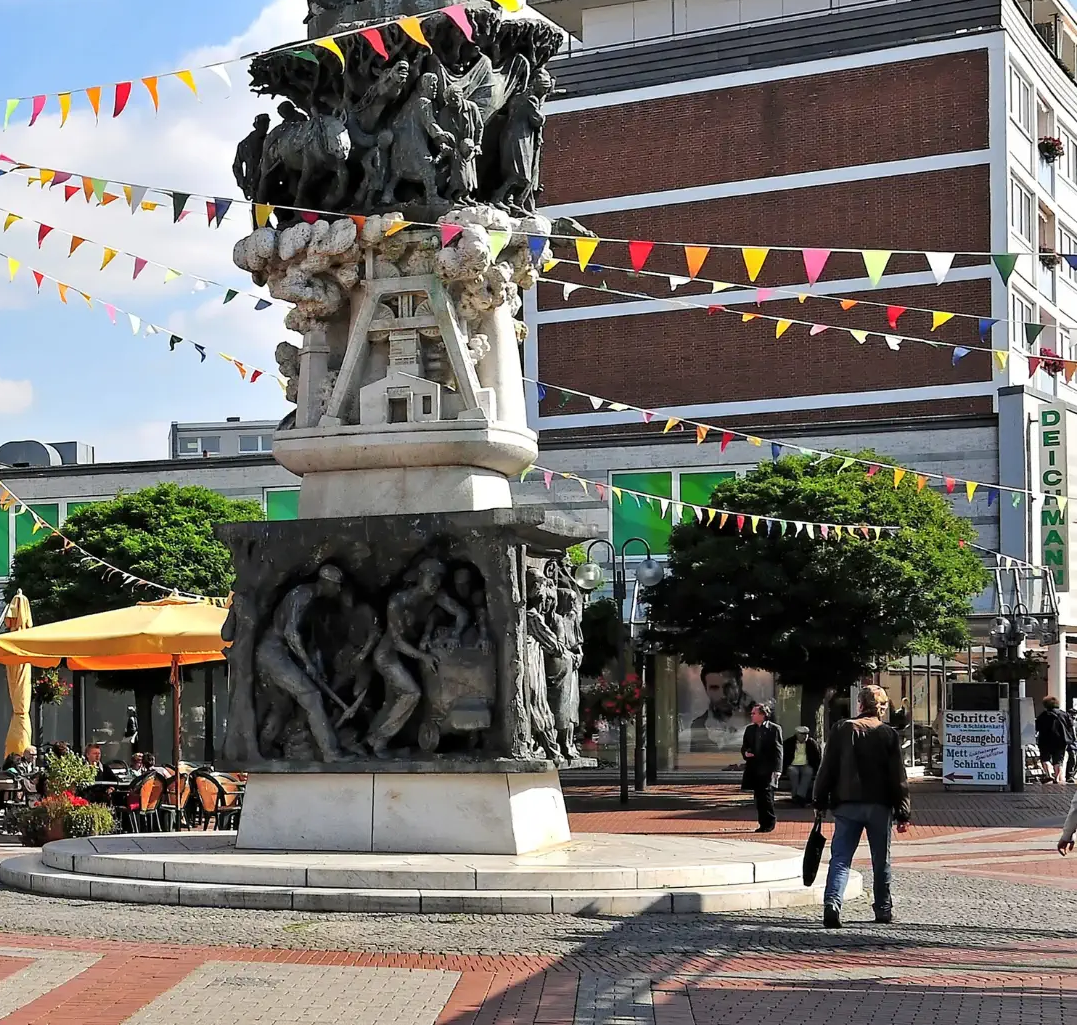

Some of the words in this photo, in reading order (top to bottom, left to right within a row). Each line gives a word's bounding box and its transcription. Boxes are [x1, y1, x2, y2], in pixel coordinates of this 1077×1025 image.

[946, 733, 1005, 746] Tagesangebot
[946, 749, 968, 758] Mett
[953, 759, 996, 769] Schinken
[977, 771, 1005, 780] Knobi
